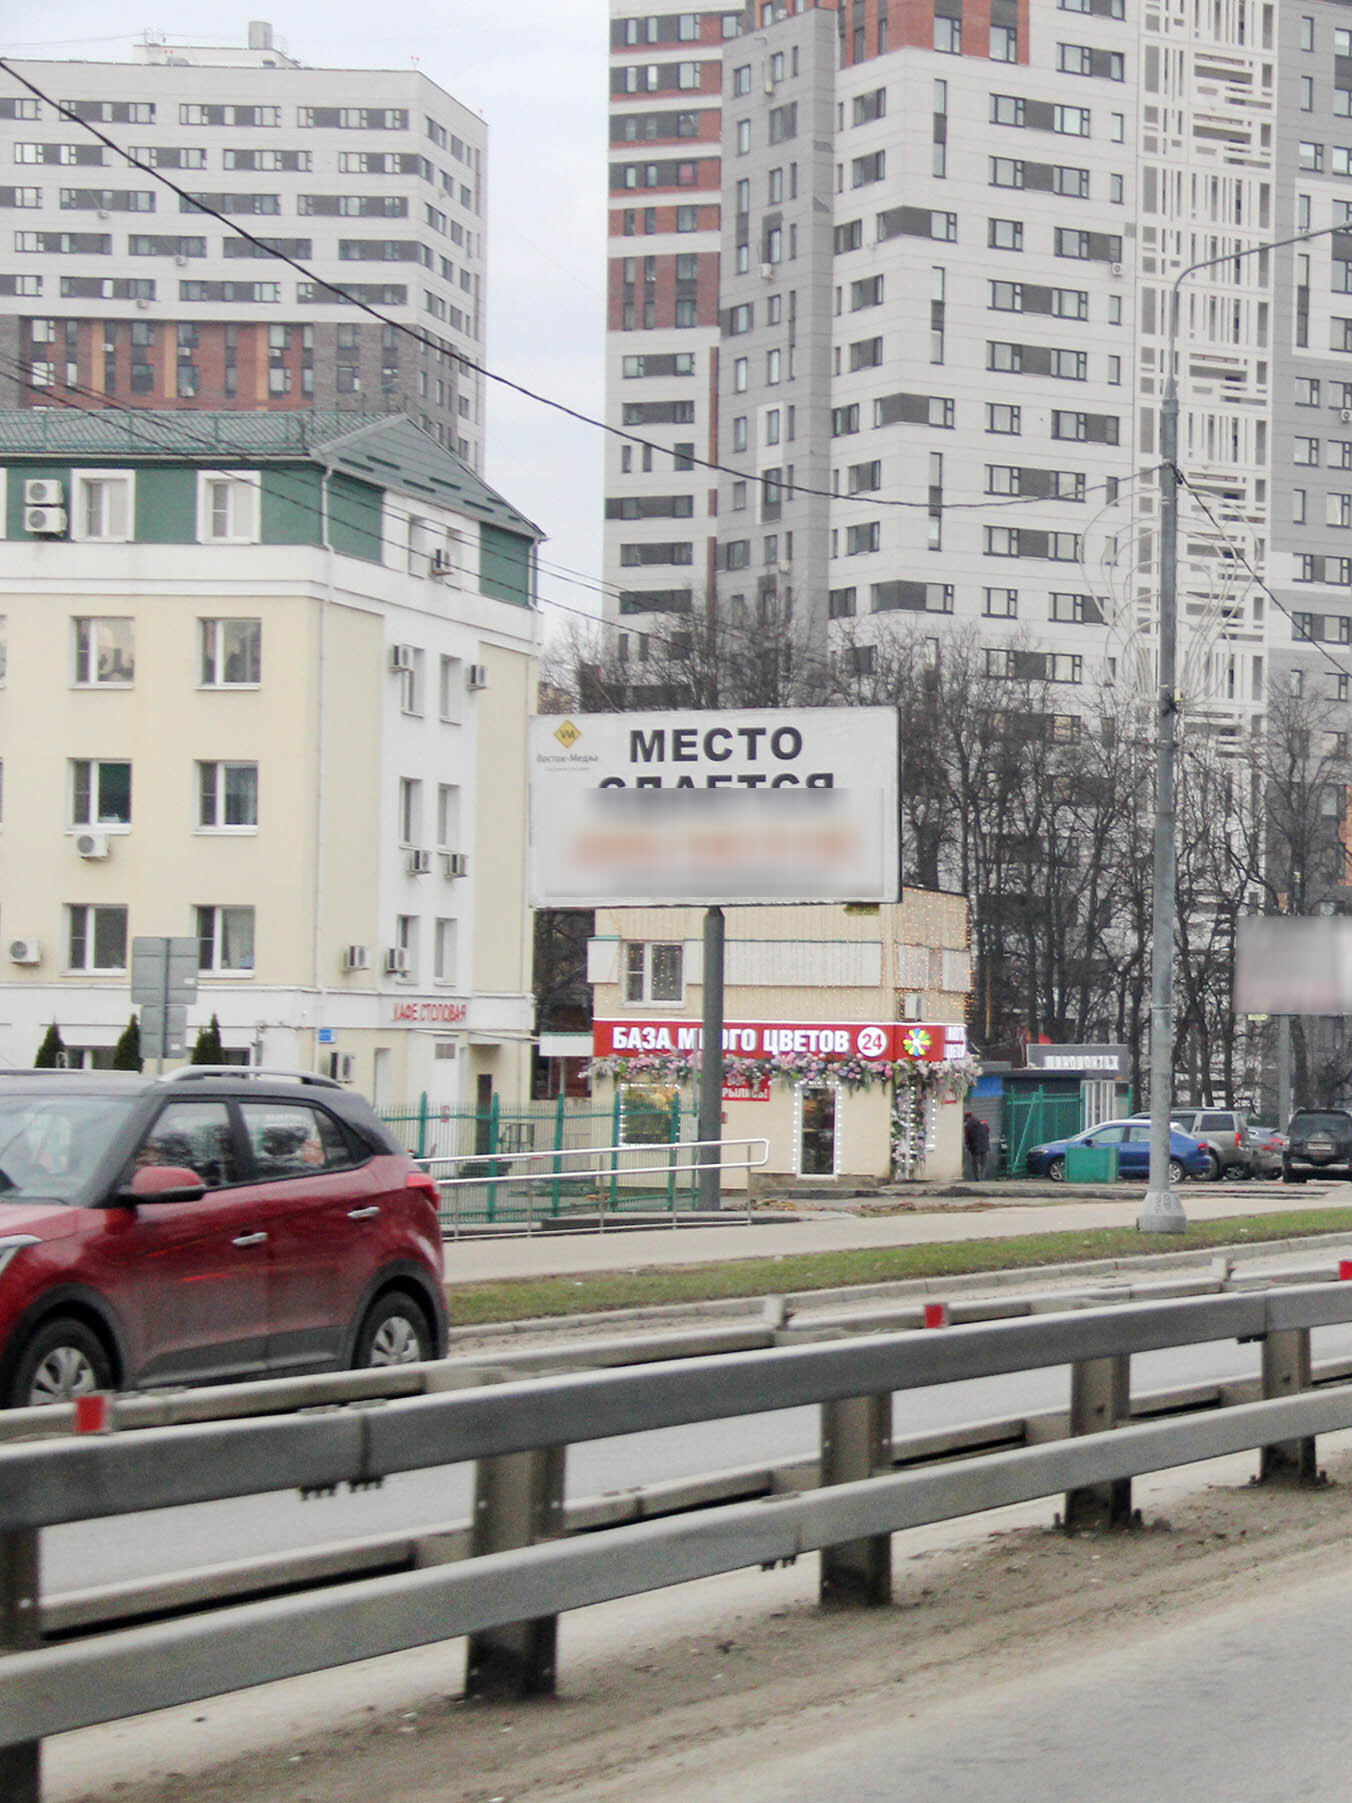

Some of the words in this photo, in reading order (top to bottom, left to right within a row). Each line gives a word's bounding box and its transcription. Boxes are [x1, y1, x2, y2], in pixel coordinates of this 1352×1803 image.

[629, 725, 803, 763] МЕСТО
[394, 1003, 418, 1021] КАФЕ
[421, 1003, 468, 1022] СТОЛОВАЯ
[612, 1026, 671, 1051] БАЗА
[763, 1029, 850, 1055] ЦВЕТОВ
[862, 1033, 883, 1051] 24
